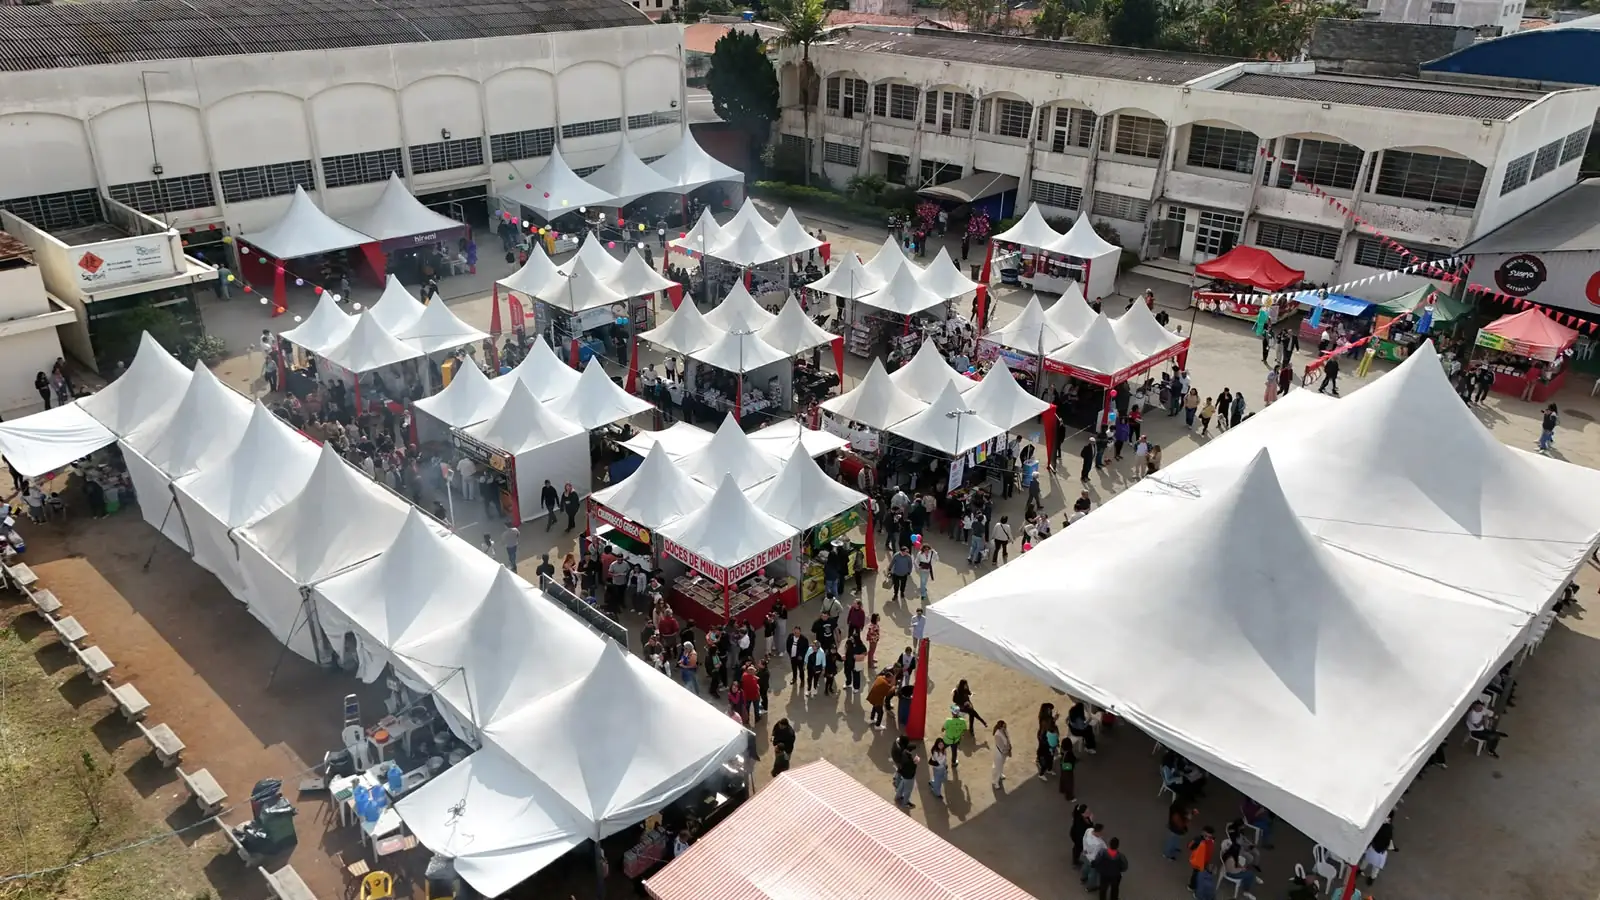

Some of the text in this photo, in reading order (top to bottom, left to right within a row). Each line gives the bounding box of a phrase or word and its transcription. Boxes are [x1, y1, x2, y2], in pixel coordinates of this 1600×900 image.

[623, 522, 639, 537] GREGO
[664, 539, 724, 583] DOCES DE MINAS
[729, 540, 792, 582] DOCES DE MINAS
